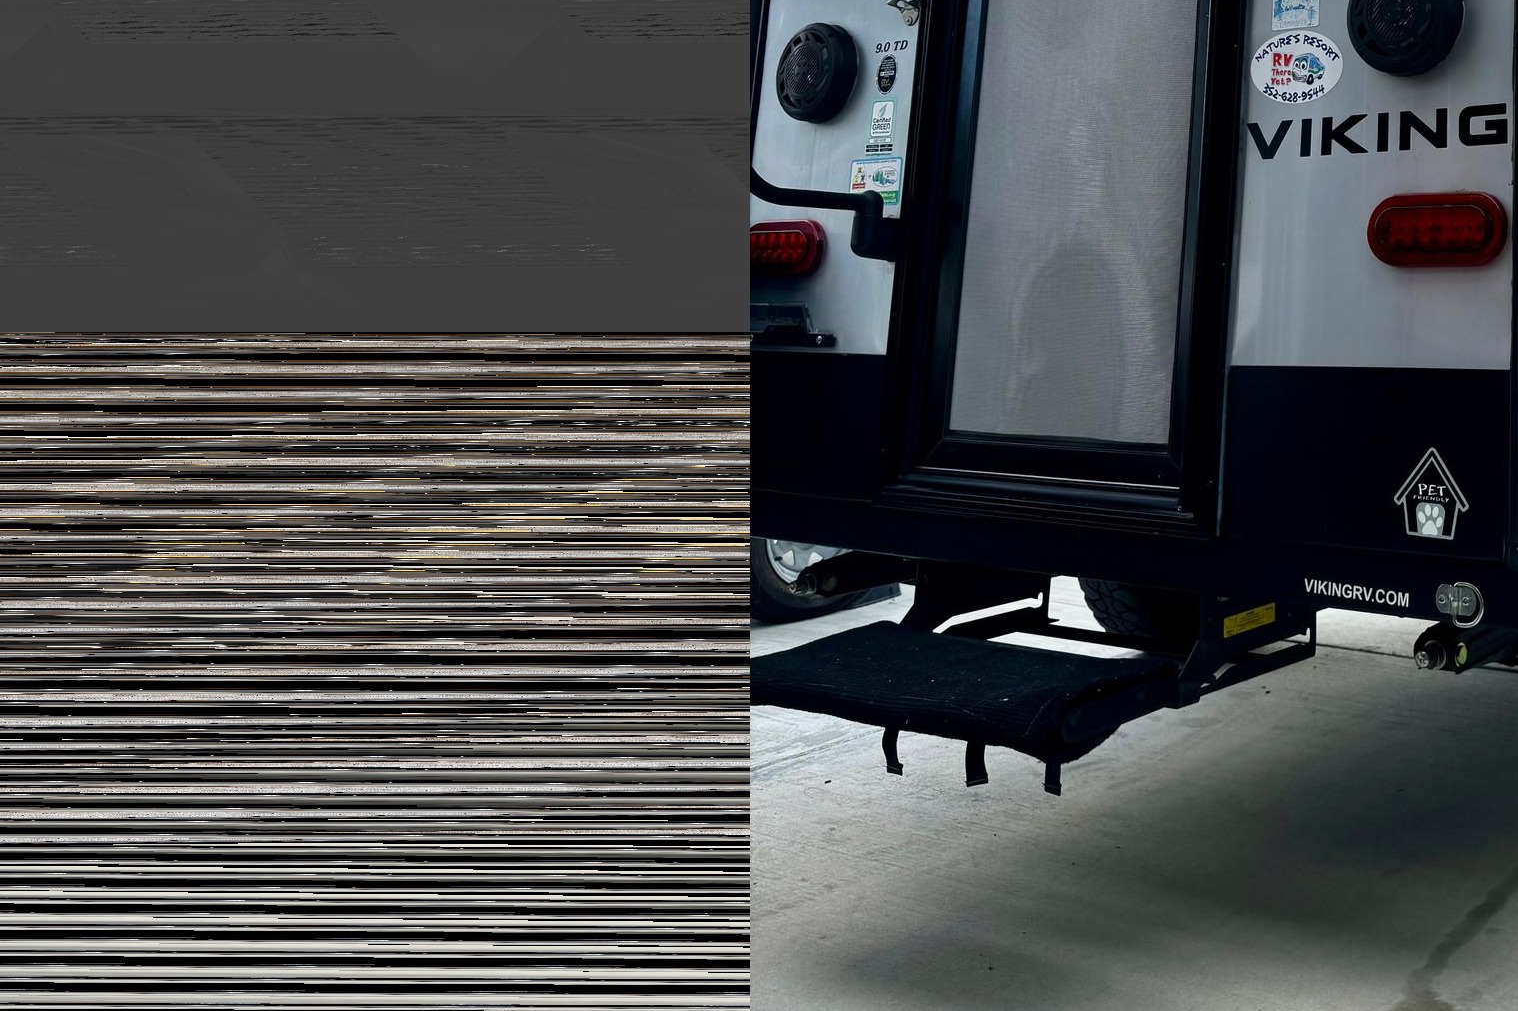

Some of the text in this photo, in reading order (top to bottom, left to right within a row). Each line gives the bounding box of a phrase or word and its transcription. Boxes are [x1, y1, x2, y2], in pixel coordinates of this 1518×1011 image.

[875, 39, 909, 53] 9.0 TD
[1255, 34, 1340, 62] NATURE'S RESORT
[1272, 52, 1293, 67] RV
[1271, 68, 1292, 76] There
[1270, 77, 1292, 86] Yet?
[1262, 82, 1325, 103] 352-628-9544
[1246, 102, 1509, 161] VIKING
[1418, 483, 1447, 497] PET
[1412, 494, 1450, 503] FRIENDLY
[1303, 578, 1410, 608] VIKINGRV.COM
